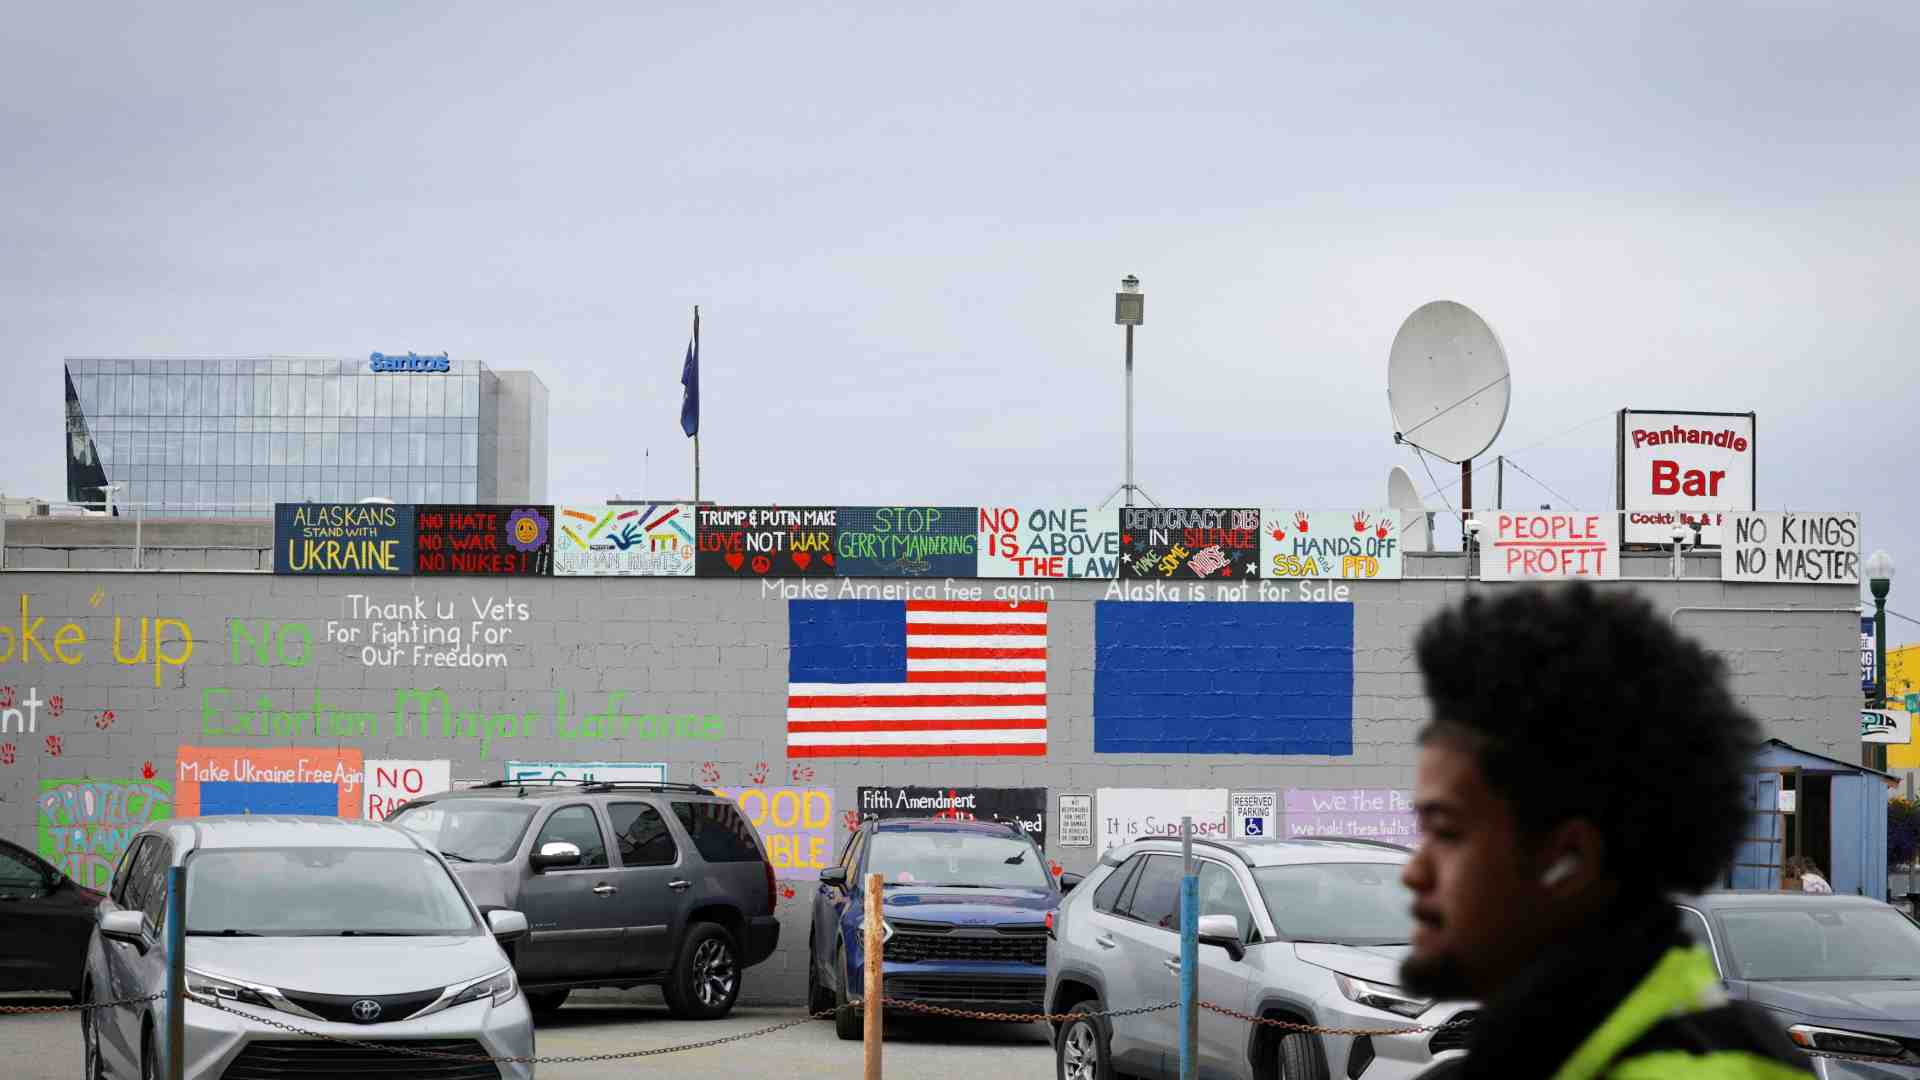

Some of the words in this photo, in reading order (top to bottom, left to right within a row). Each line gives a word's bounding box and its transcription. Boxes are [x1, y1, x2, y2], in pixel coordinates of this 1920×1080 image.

[370, 352, 449, 372] Santos
[1632, 424, 1747, 452] Panhandle
[1651, 460, 1726, 497] Bar
[294, 507, 396, 528] ALASKANS
[419, 513, 442, 530] NO
[449, 513, 497, 531] HATE
[700, 510, 746, 526] TRUMP
[748, 510, 757, 526] &
[761, 510, 800, 526] PUTIN
[804, 510, 836, 526] MAKE
[873, 508, 941, 533] STOP
[979, 508, 1019, 533] NO
[1028, 508, 1088, 533] ONE
[1125, 508, 1227, 529] DEMOCRACY
[1232, 509, 1259, 530] DIES
[1500, 515, 1599, 539] PEOPLE
[1631, 513, 1694, 524] Cocktils
[304, 528, 344, 537] STAND
[346, 527, 377, 537] WITH
[419, 535, 442, 550] NO
[449, 535, 497, 550] WAR
[700, 532, 743, 552] LOVE
[746, 533, 786, 552] NOT
[790, 532, 829, 551] WAR
[1149, 529, 1168, 545] IN
[1184, 528, 1256, 549] SILENCE
[1736, 518, 1766, 544] NO
[1782, 516, 1857, 547] KINGS
[288, 539, 400, 571] UKRAINE
[989, 534, 1020, 558] IS
[1026, 532, 1119, 555] ABOVE
[1293, 537, 1361, 557] HANDS
[1366, 537, 1397, 558] OFF
[419, 554, 445, 573] NO
[1010, 556, 1064, 577] THE
[1067, 557, 1120, 577] LAW
[1132, 549, 1161, 576] MAKE
[1158, 543, 1190, 577] SOME
[1187, 545, 1230, 578] NOISE
[1273, 553, 1319, 577] SSA
[1343, 555, 1379, 577] PFD
[1507, 548, 1607, 575] PROFIT
[1736, 550, 1766, 575] NO
[1777, 551, 1858, 580] MASTER
[761, 578, 828, 599] Make
[837, 577, 936, 600] America
[943, 578, 982, 600] free
[993, 582, 1055, 608] again
[1104, 580, 1180, 602] Alaska
[1188, 581, 1205, 602] is
[1217, 581, 1249, 602] not
[1258, 580, 1289, 602] for
[1299, 580, 1350, 602] Sale
[347, 595, 427, 620] Thank
[436, 600, 454, 620] u
[472, 596, 530, 621] Vets
[228, 617, 313, 668] NO
[327, 622, 360, 643] For
[372, 621, 460, 652] Fighting
[471, 621, 512, 645] For
[113, 615, 194, 688] up
[362, 646, 404, 667] Our
[413, 644, 508, 668] Freedom
[202, 688, 377, 737] Extortion
[395, 689, 543, 759] Mayor
[180, 760, 229, 783] Make
[234, 758, 294, 783] Ukraine
[298, 759, 333, 783] Free
[376, 767, 423, 793] NO
[714, 788, 832, 830] OOD
[863, 790, 893, 809] Fifth
[895, 789, 977, 809] Amendment
[1234, 796, 1272, 806] RESERVED
[1238, 807, 1270, 816] PARKING
[1106, 817, 1121, 835] It
[1127, 817, 1138, 835] is
